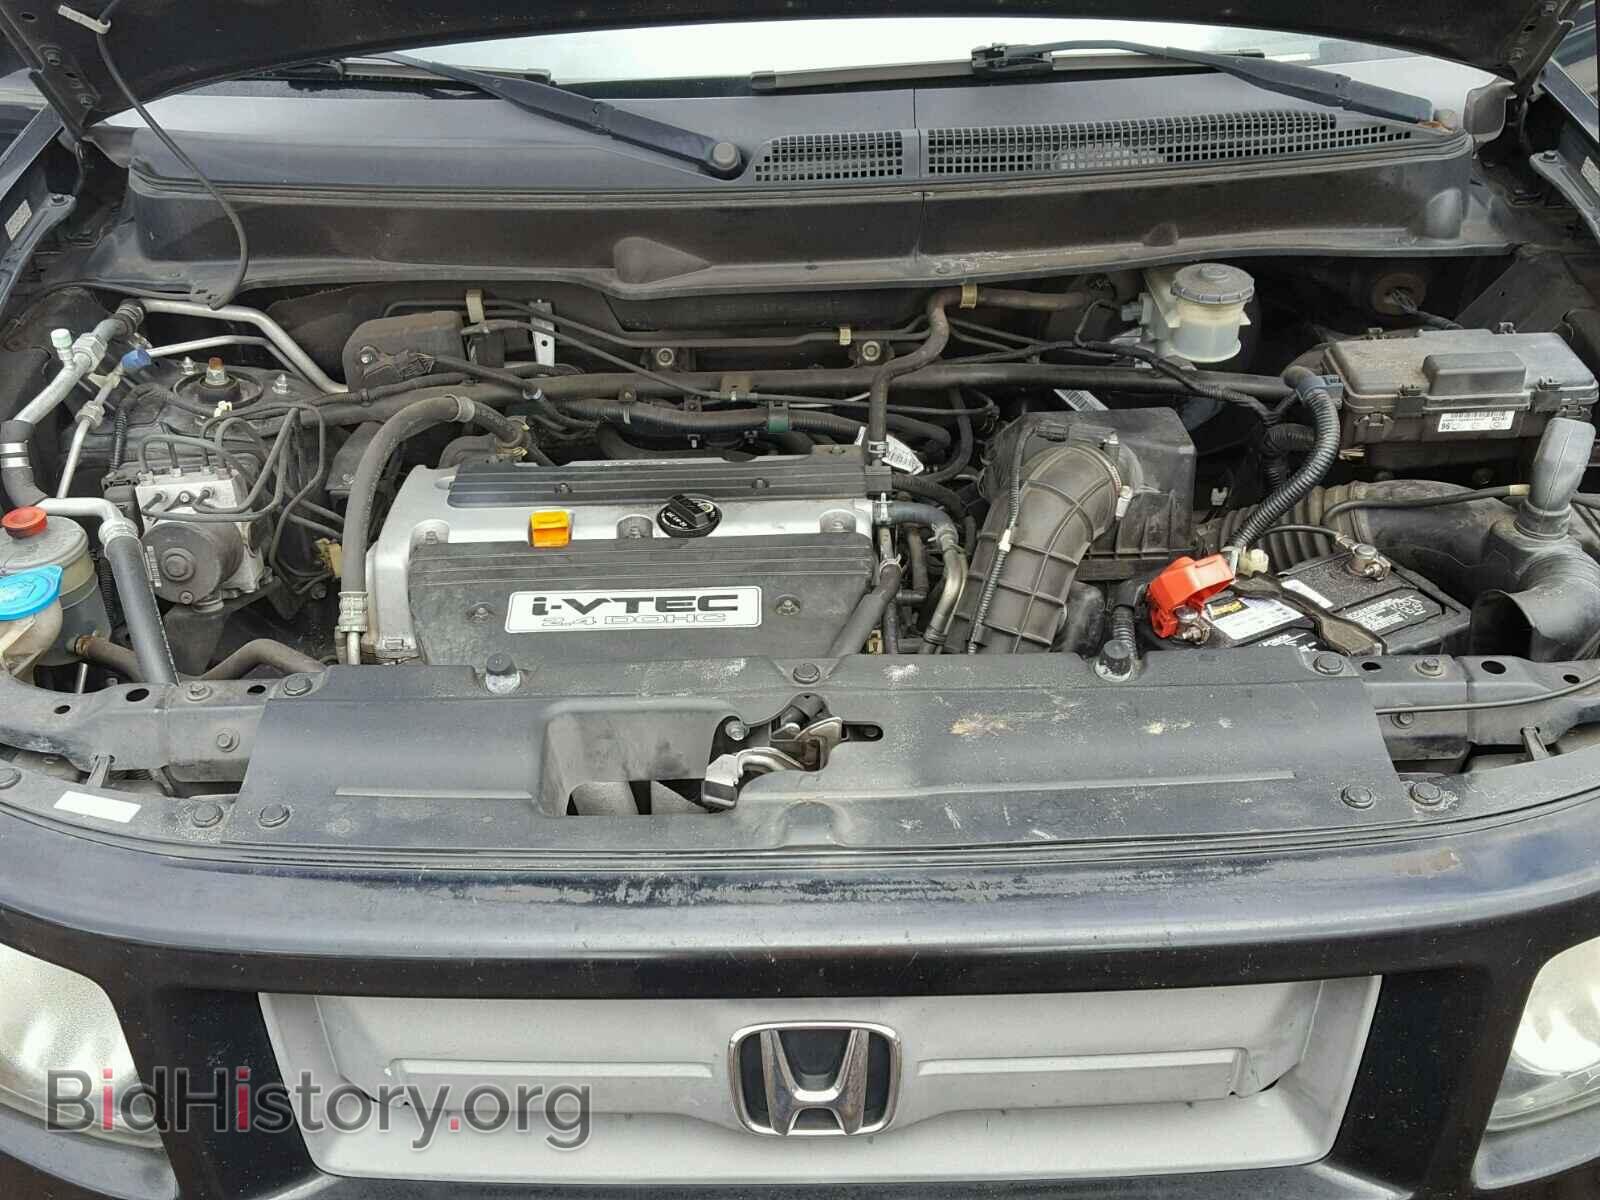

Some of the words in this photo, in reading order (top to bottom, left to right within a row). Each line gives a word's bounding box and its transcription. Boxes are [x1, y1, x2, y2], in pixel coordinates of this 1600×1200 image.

[532, 594, 739, 616] i-VTEC
[541, 615, 598, 627] 2.4
[604, 613, 727, 625] DOHC
